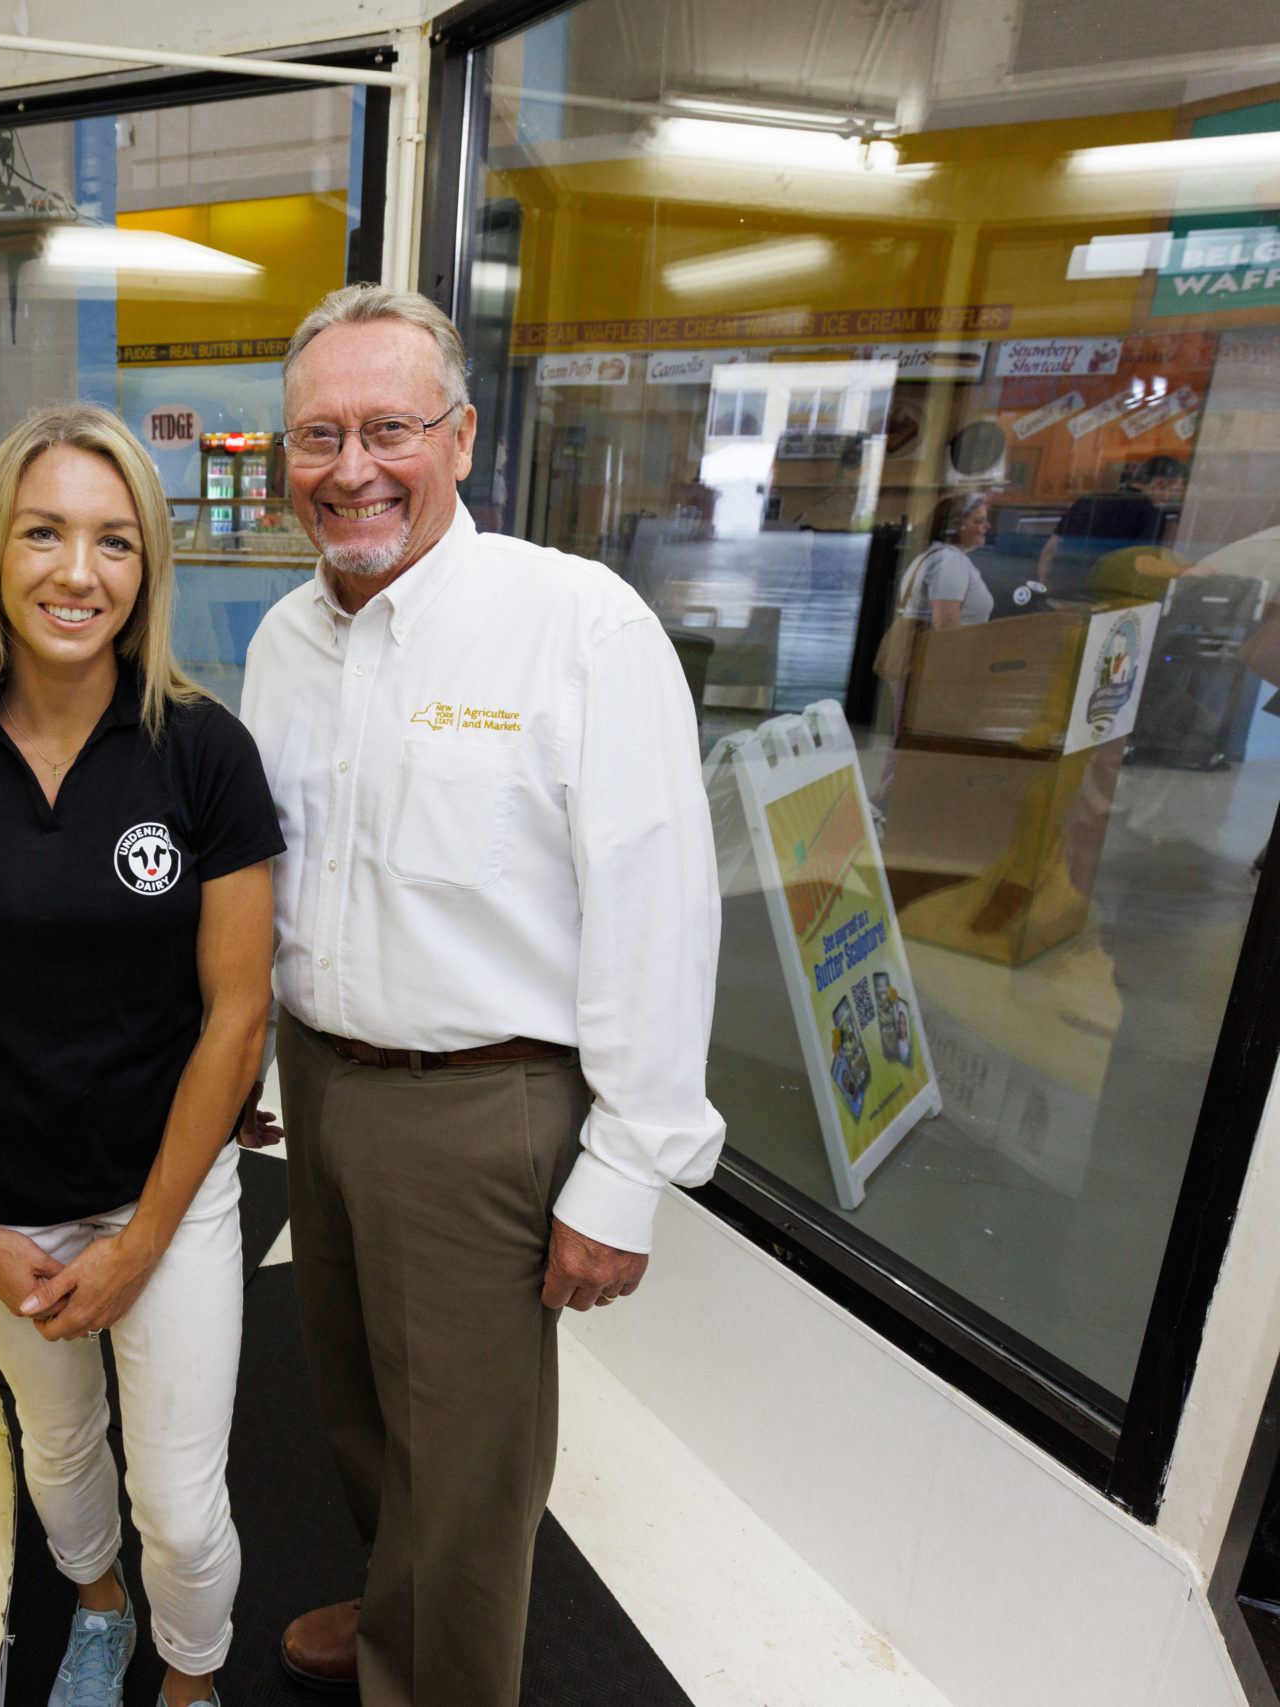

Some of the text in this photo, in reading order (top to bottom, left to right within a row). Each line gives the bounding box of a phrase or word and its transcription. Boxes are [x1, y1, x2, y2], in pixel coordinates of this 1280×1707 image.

[528, 324, 577, 345] CREAM
[583, 321, 649, 342] WAFFLES
[652, 319, 678, 340] ICE
[683, 317, 739, 338] CREAM
[744, 314, 817, 337] WAFFLES
[821, 313, 851, 334] ICE
[856, 310, 917, 332] CREAM
[923, 307, 1004, 330] WAFFLES
[124, 346, 157, 361] FUDGE
[170, 344, 196, 359] REAL
[198, 342, 239, 358] BUTTER
[241, 341, 253, 355] IN
[1008, 340, 1084, 361] Strawberry
[651, 355, 704, 379] Cannolis
[151, 413, 193, 441] FUDGE
[434, 718, 454, 726] STATE
[435, 711, 454, 719] YORK
[463, 707, 520, 720] Agriculture
[462, 720, 522, 732] and Markets
[135, 876, 170, 892] DAIRY
[813, 915, 887, 993] Butter Sculpture!
